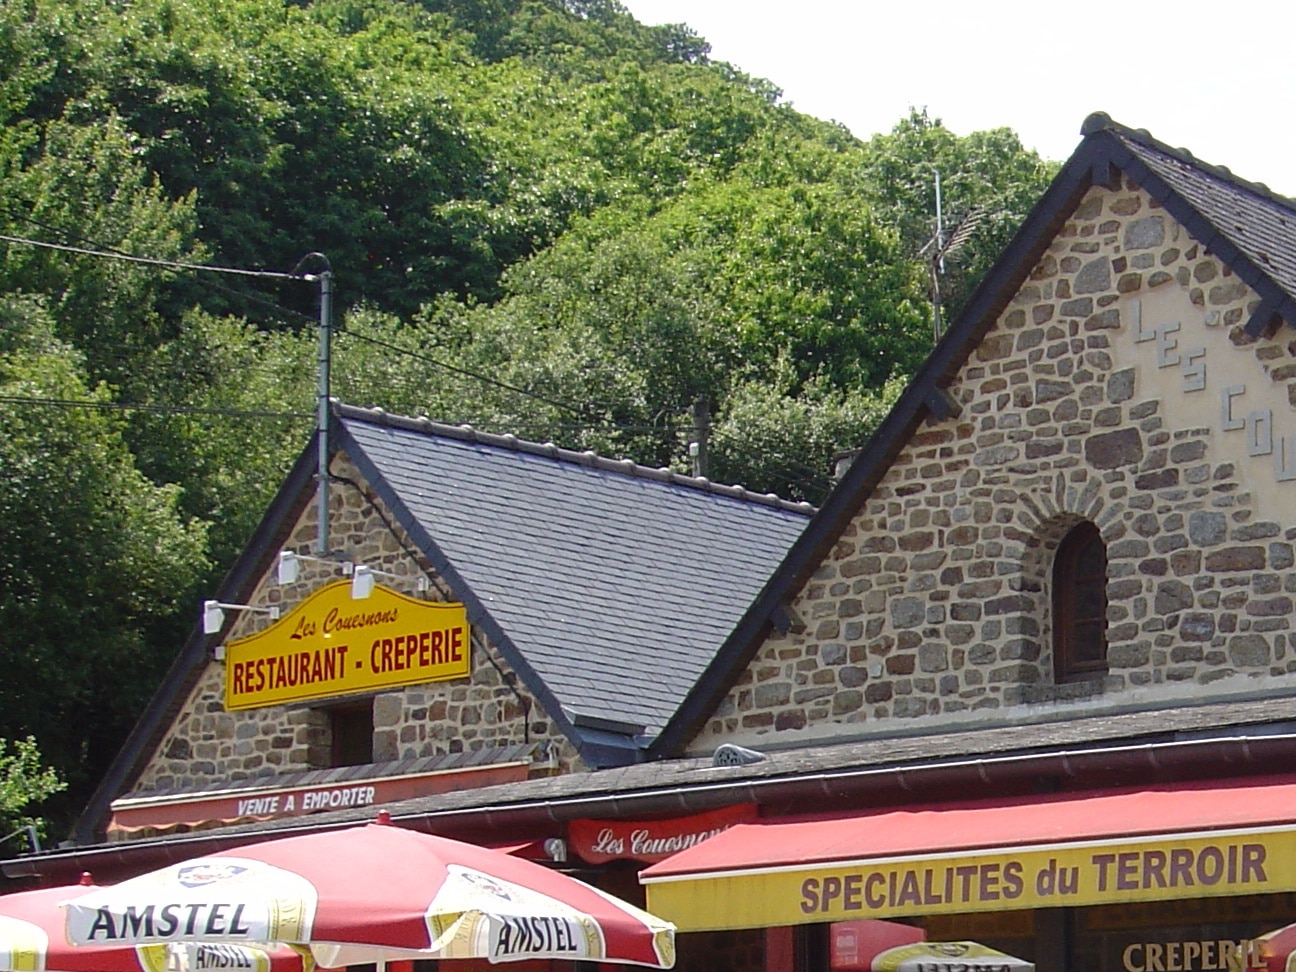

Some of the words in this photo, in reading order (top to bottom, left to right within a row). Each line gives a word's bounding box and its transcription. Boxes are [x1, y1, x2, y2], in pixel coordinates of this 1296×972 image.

[1132, 300, 1206, 394] LES
[290, 616, 316, 640] Les
[323, 607, 400, 634] Couesnons
[233, 646, 348, 695] RESTAURANT
[371, 627, 463, 674] CREPERIE
[237, 796, 279, 816] VENTE
[284, 795, 295, 812] A
[302, 786, 375, 810] EMPORTER
[591, 828, 624, 854] Les
[631, 824, 731, 854] Couesno
[800, 861, 1025, 914] SPECIALITES
[1036, 858, 1079, 896] du
[1092, 843, 1268, 892] TERROIR
[88, 903, 251, 941] AMSTEL
[495, 915, 577, 957] AMSTEL
[196, 945, 251, 969] AMSTEL
